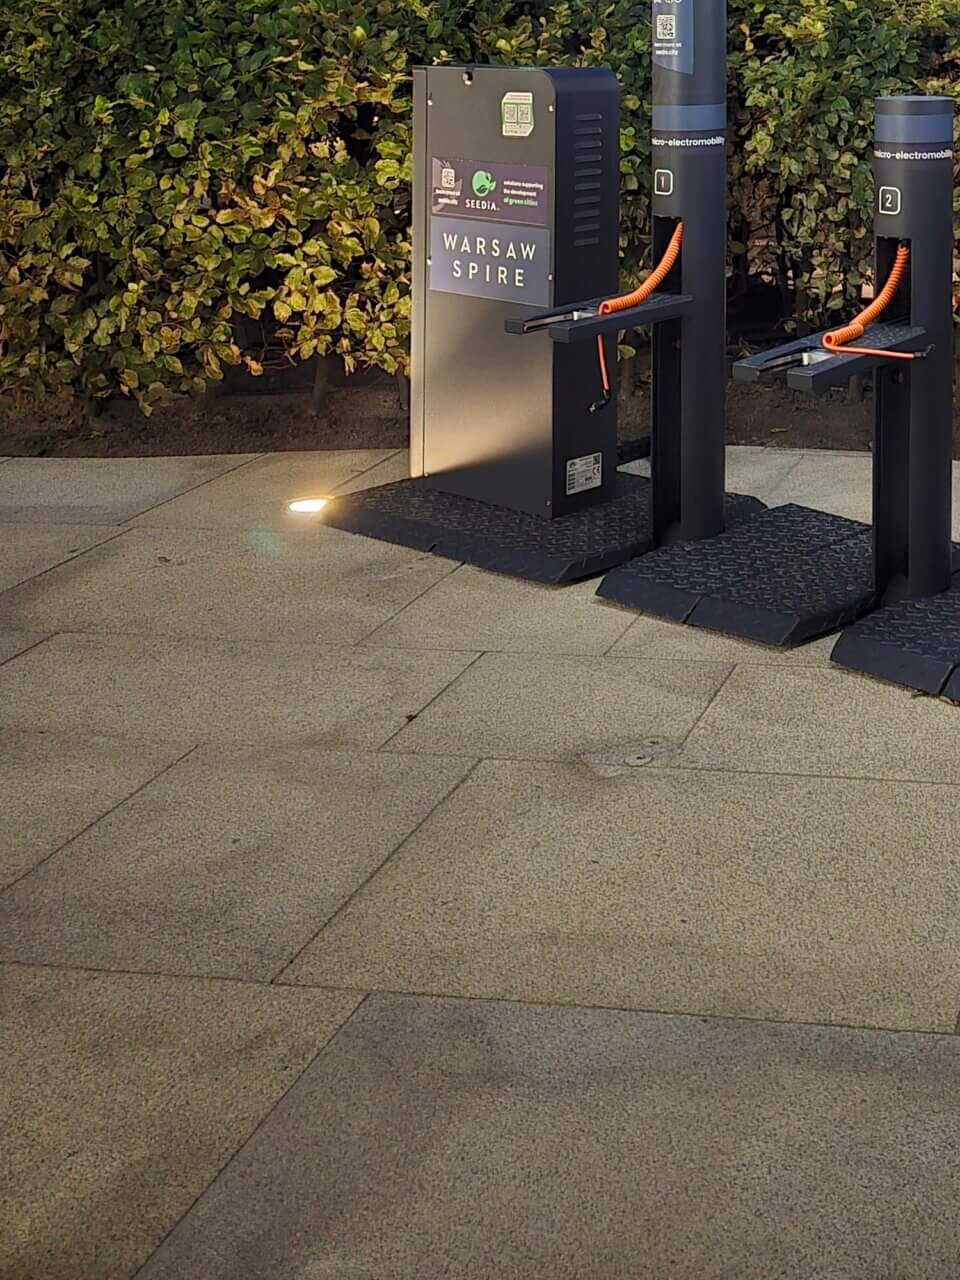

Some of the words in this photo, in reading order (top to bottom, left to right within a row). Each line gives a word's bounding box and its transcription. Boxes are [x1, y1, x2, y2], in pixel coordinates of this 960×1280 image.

[885, 194, 892, 207] 2
[443, 232, 536, 261] WARSAW
[452, 260, 524, 287] SPIRE
